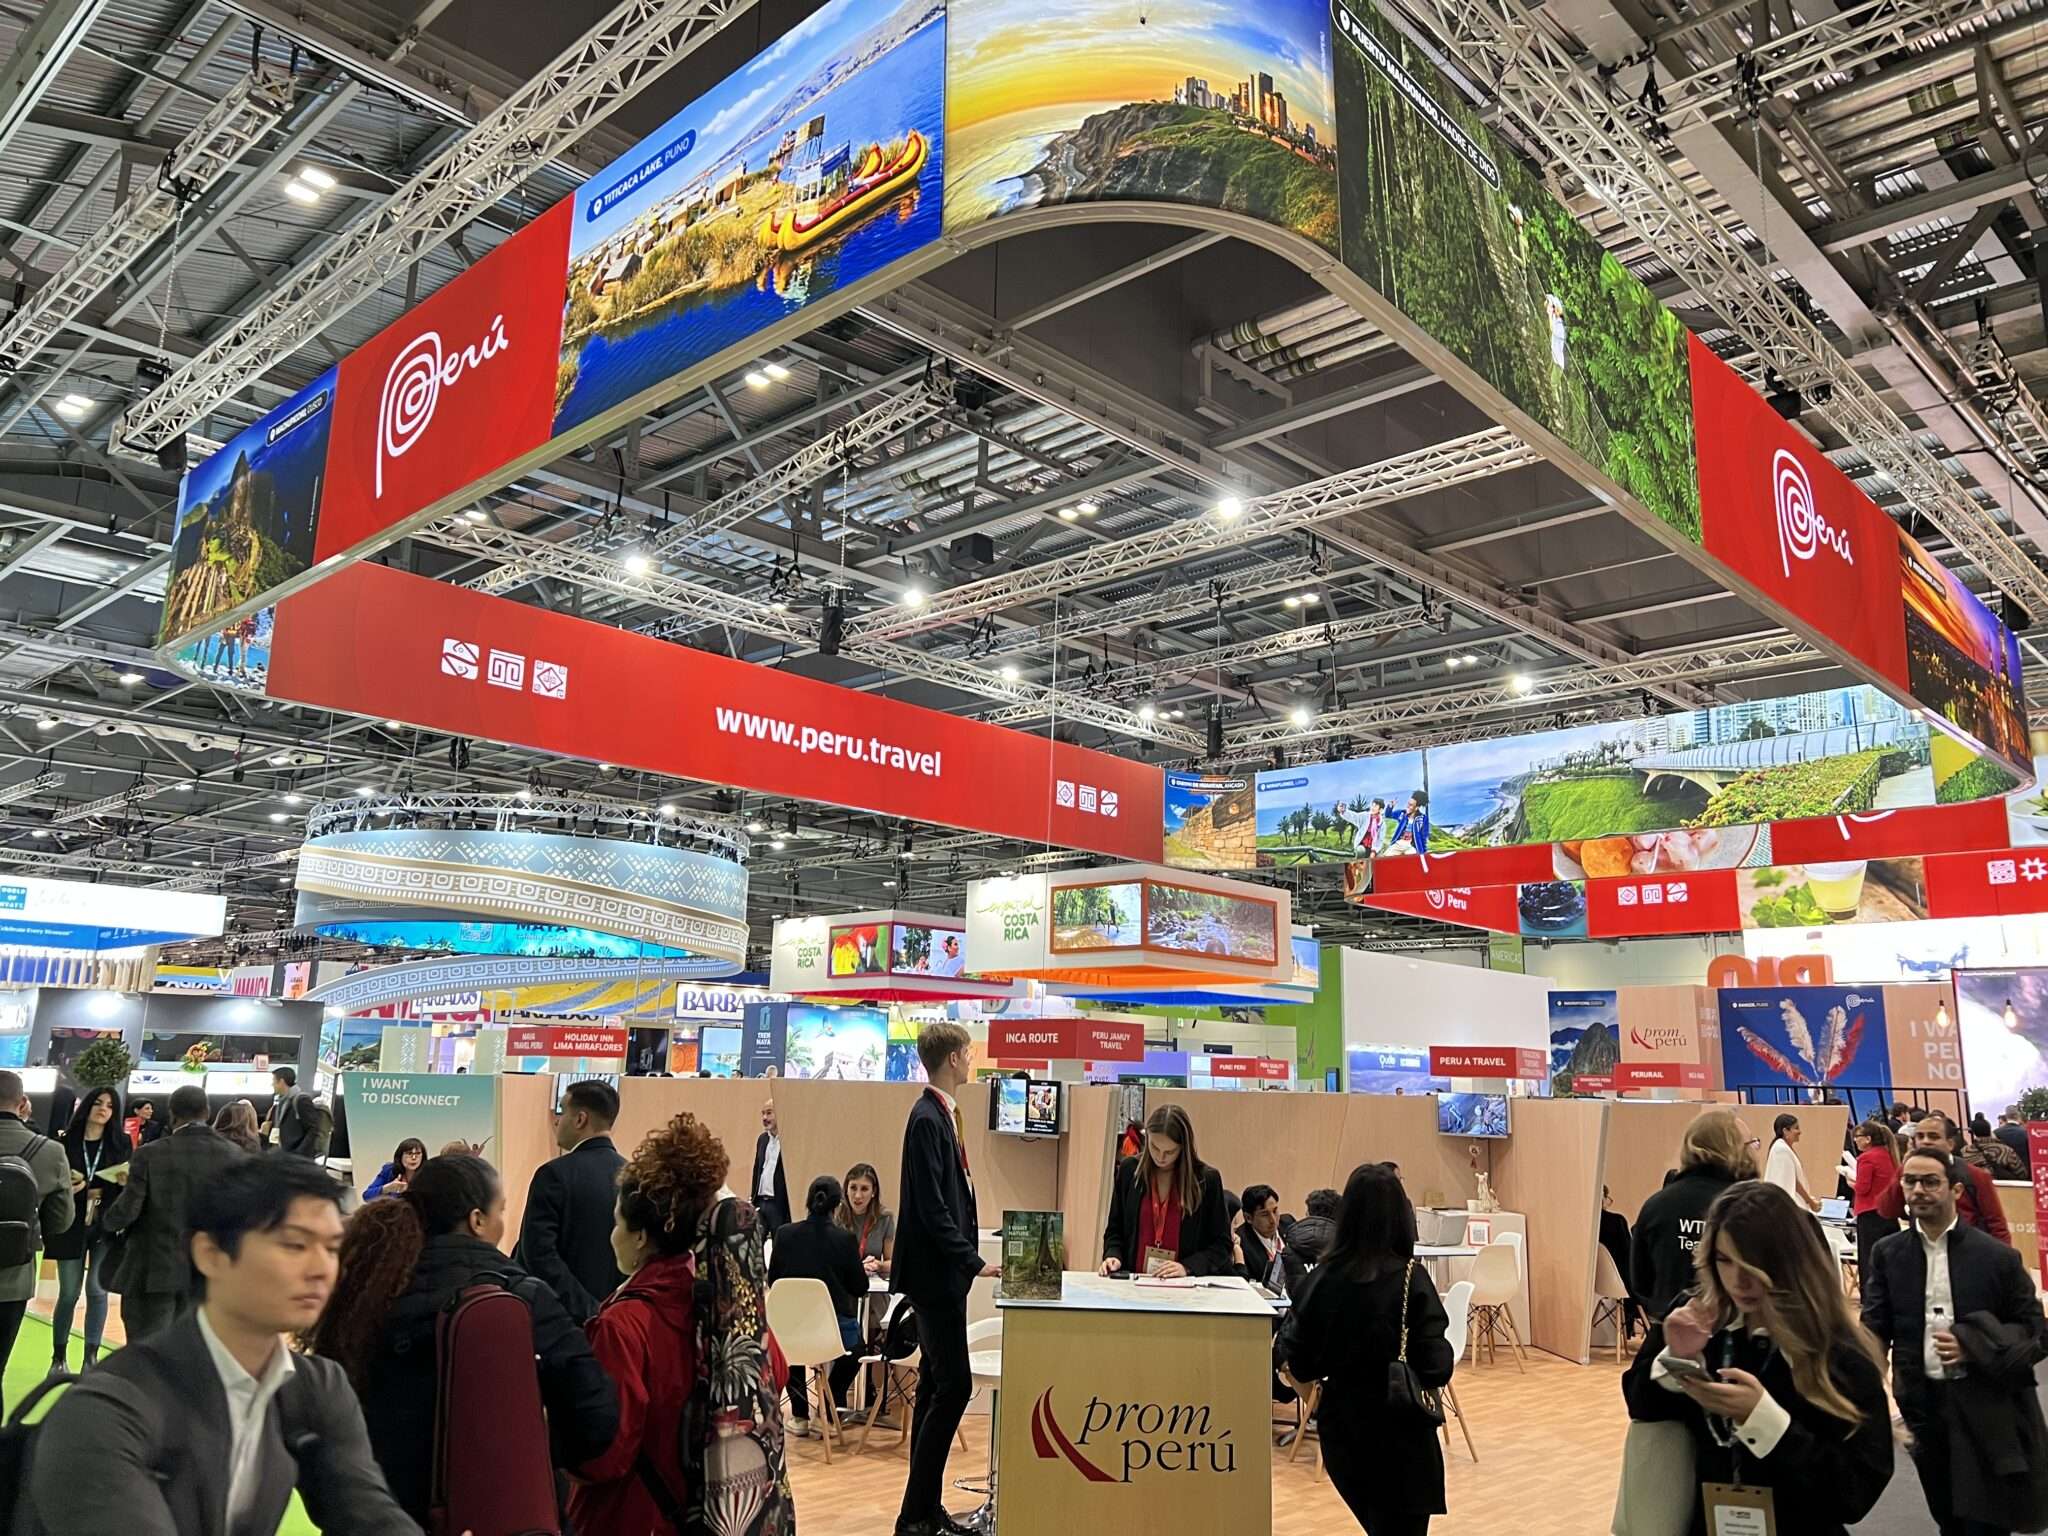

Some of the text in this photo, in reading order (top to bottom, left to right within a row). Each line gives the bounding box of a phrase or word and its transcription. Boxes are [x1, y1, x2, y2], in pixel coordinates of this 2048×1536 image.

[1351, 21, 1497, 182] PUERTO MALDONADO, MADRE DE DIOS
[603, 137, 690, 206] TITICACA LAKE, PUNO
[376, 313, 509, 499] Perú
[1772, 447, 1853, 579] Perú
[715, 706, 942, 777] www.peru.travel
[1447, 893, 1467, 910] Peru
[1004, 912, 1039, 927] COSTA
[1004, 927, 1029, 940] RICA
[797, 946, 822, 958] COSTA
[797, 958, 816, 969] RICA
[564, 1033, 614, 1042] HOLIDAY INN
[1006, 1033, 1059, 1044] INCA ROUTE
[1092, 1031, 1108, 1040] PERU
[1643, 1026, 1680, 1041] prom
[553, 1041, 623, 1052] LIMA MIRAFLORES
[1099, 1040, 1123, 1050] TRAVEL
[1655, 1034, 1688, 1050] perú
[1923, 1042, 1960, 1060] PE
[1439, 1056, 1506, 1067] PERU A TRAVEL
[1631, 1071, 1664, 1079] PERURAIL
[362, 1077, 410, 1090] I WANT
[361, 1093, 461, 1106] TO DISCONNECT
[1679, 1218, 1707, 1234] WT
[1074, 1395, 1213, 1445] prom
[1118, 1429, 1237, 1484] perú
